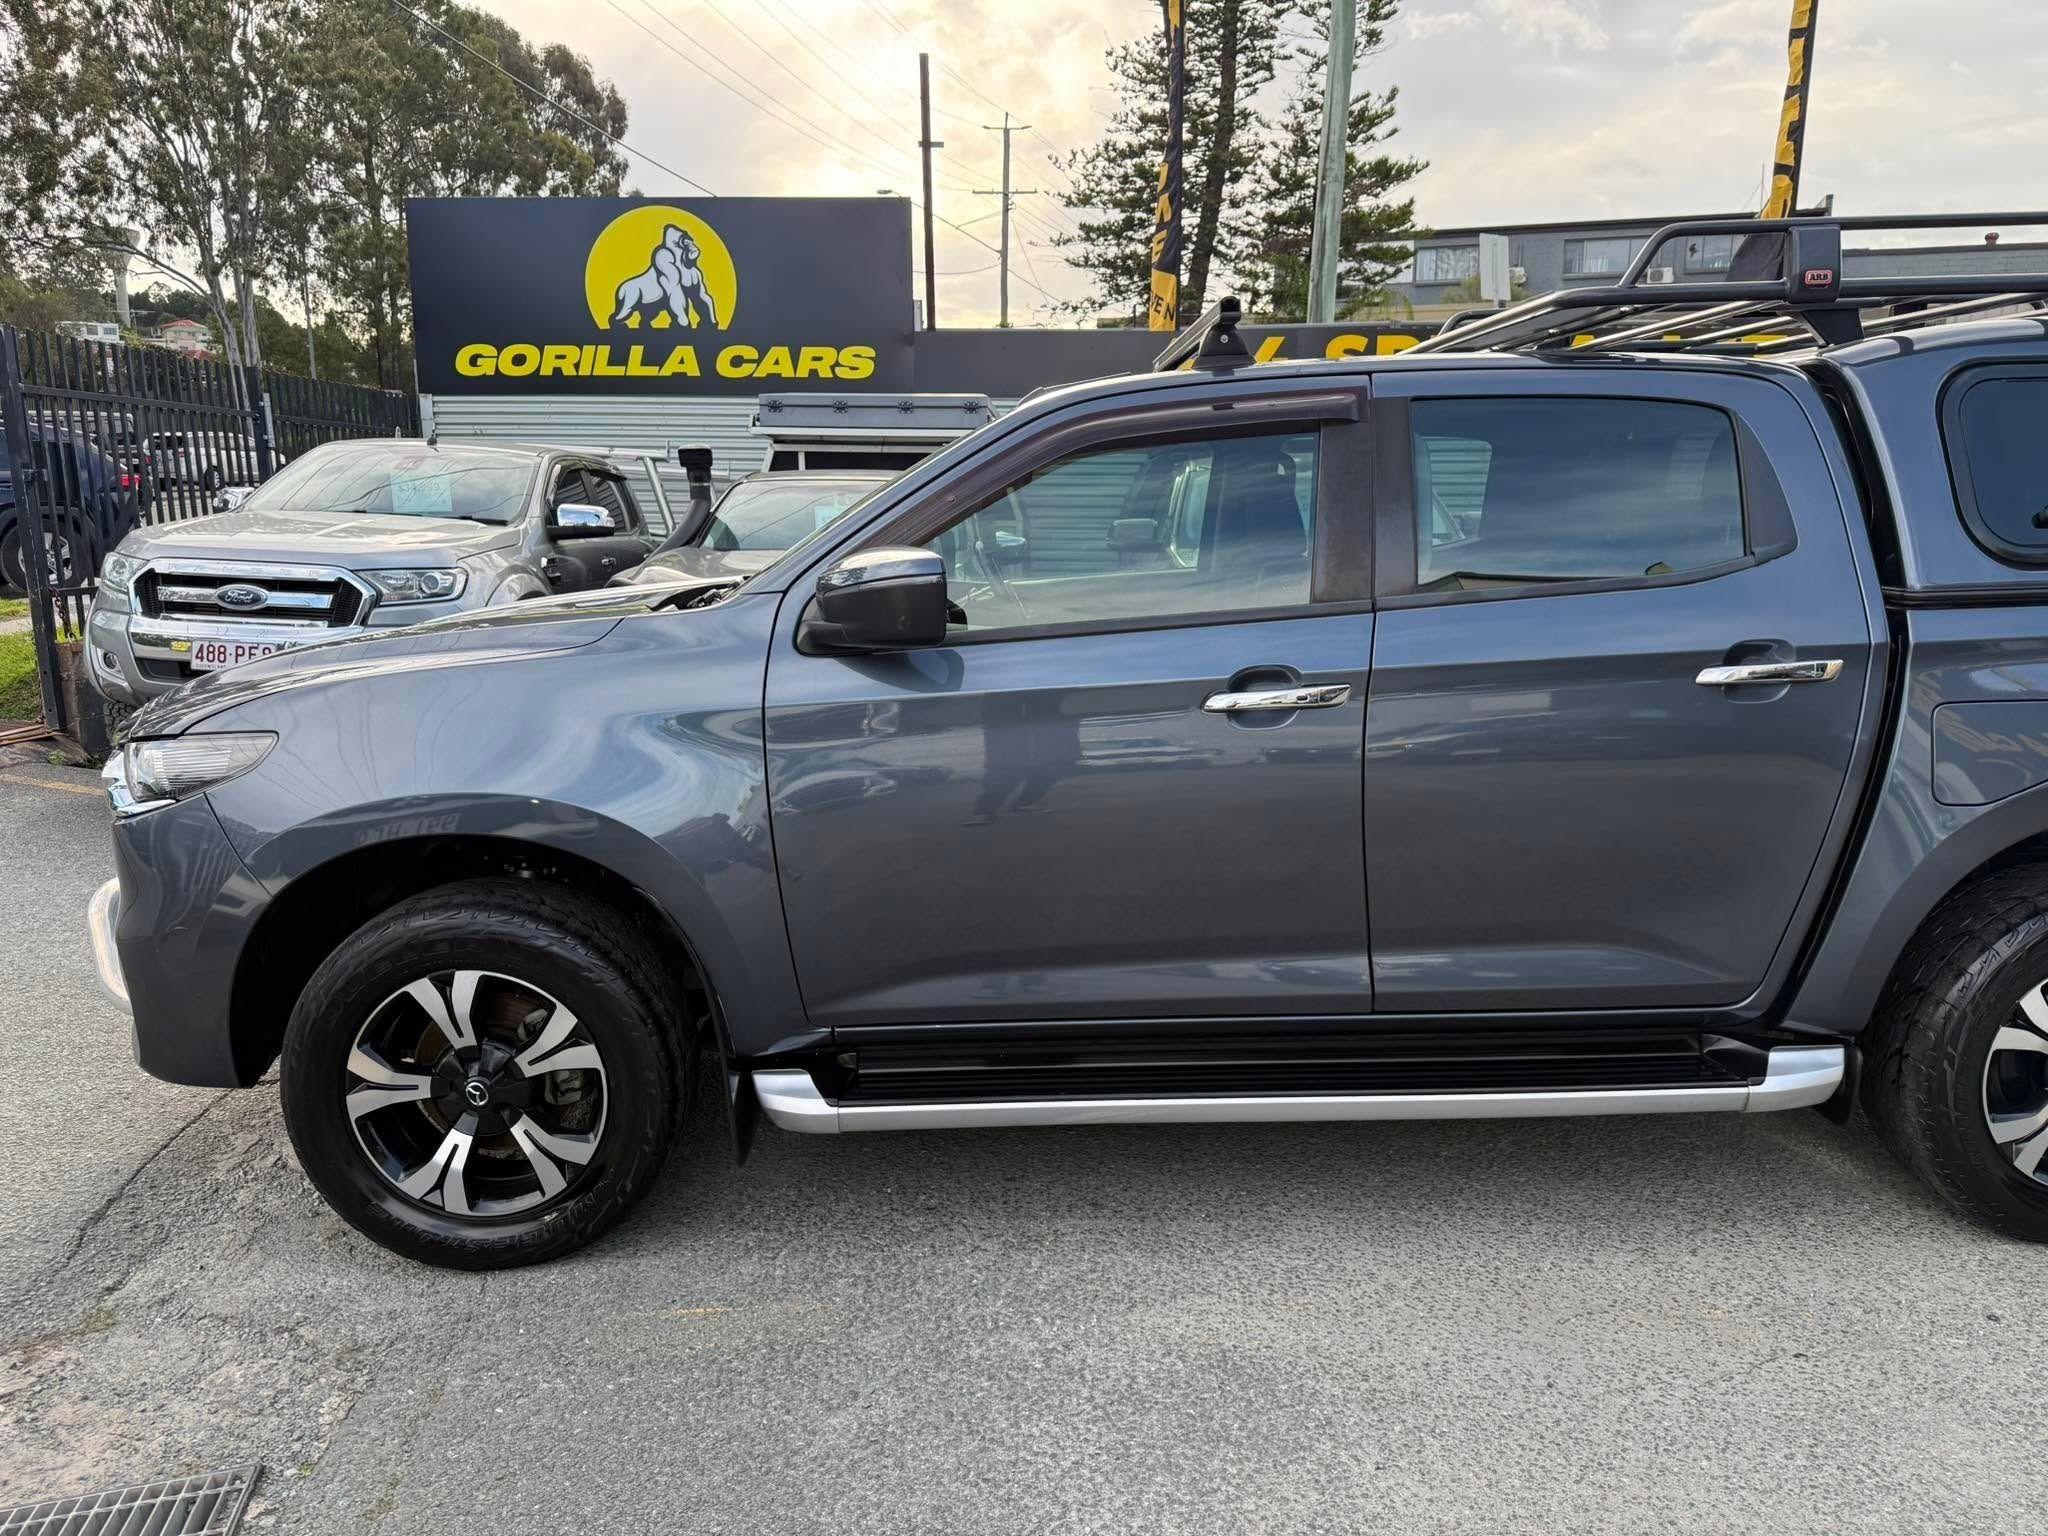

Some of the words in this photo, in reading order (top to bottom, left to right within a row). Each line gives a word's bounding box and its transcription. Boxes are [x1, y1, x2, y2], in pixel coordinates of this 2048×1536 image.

[1808, 272, 1830, 281] ARB
[454, 343, 701, 377] GORILLA
[715, 346, 876, 379] CARS
[225, 589, 254, 602] Ford
